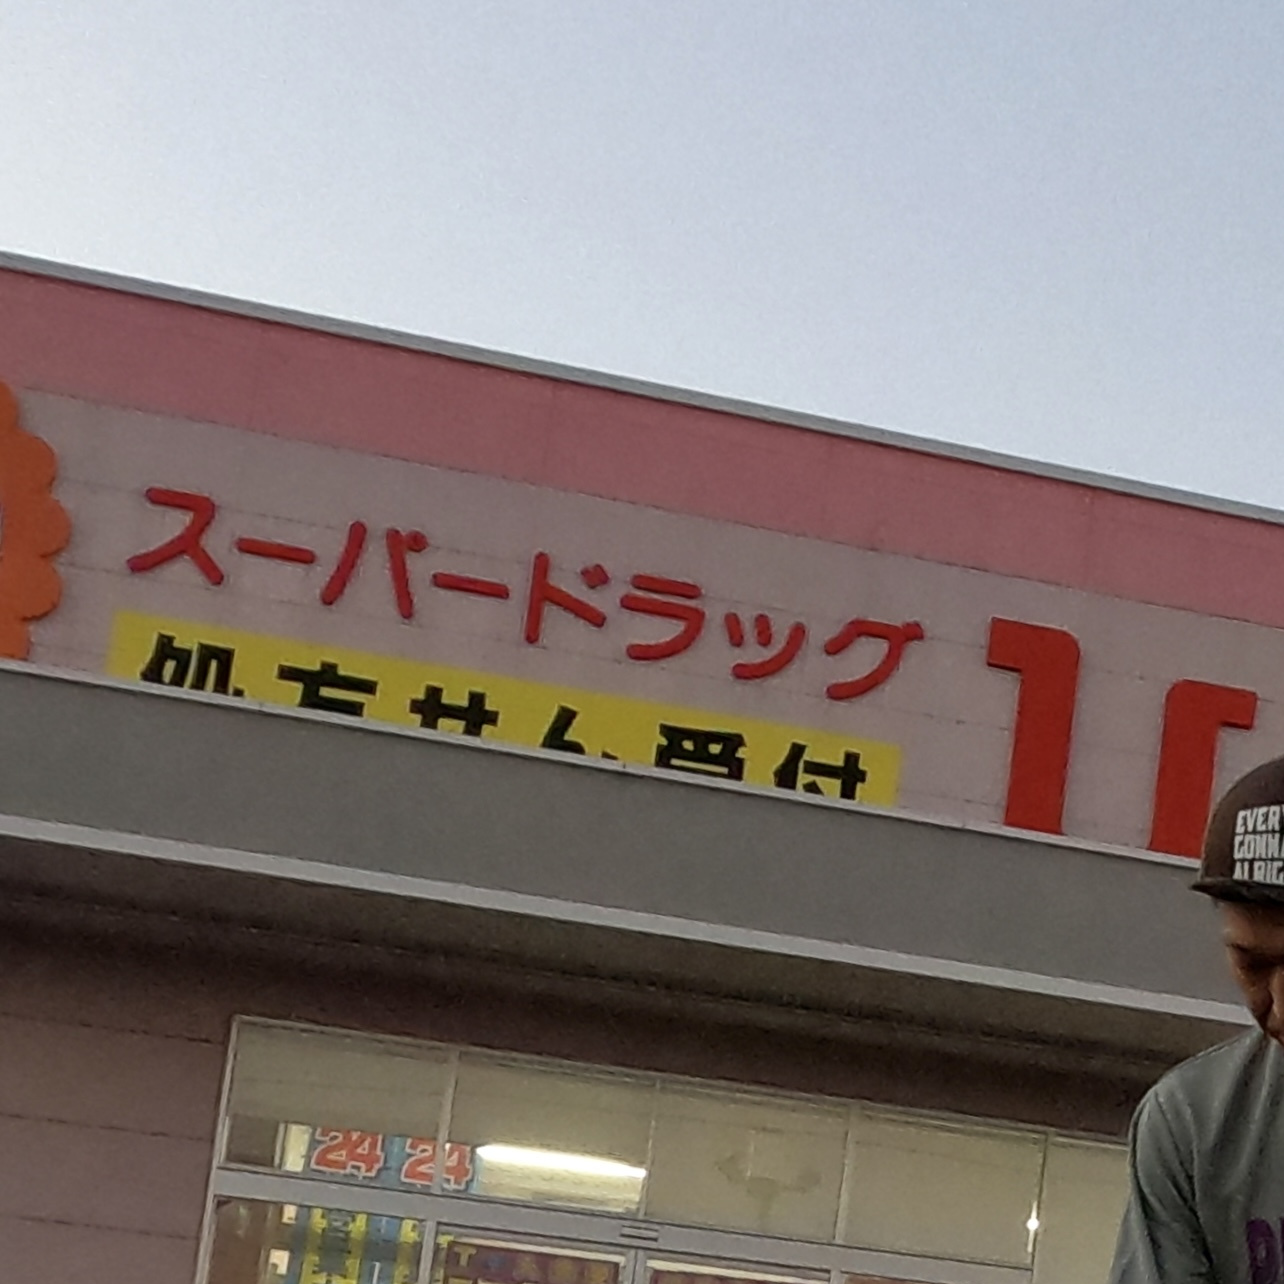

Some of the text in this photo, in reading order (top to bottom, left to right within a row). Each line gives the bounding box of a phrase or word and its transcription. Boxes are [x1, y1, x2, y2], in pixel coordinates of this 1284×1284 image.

[126, 486, 925, 702] スーパードラッグ
[310, 1127, 385, 1180] 24
[401, 1137, 473, 1190] 24
